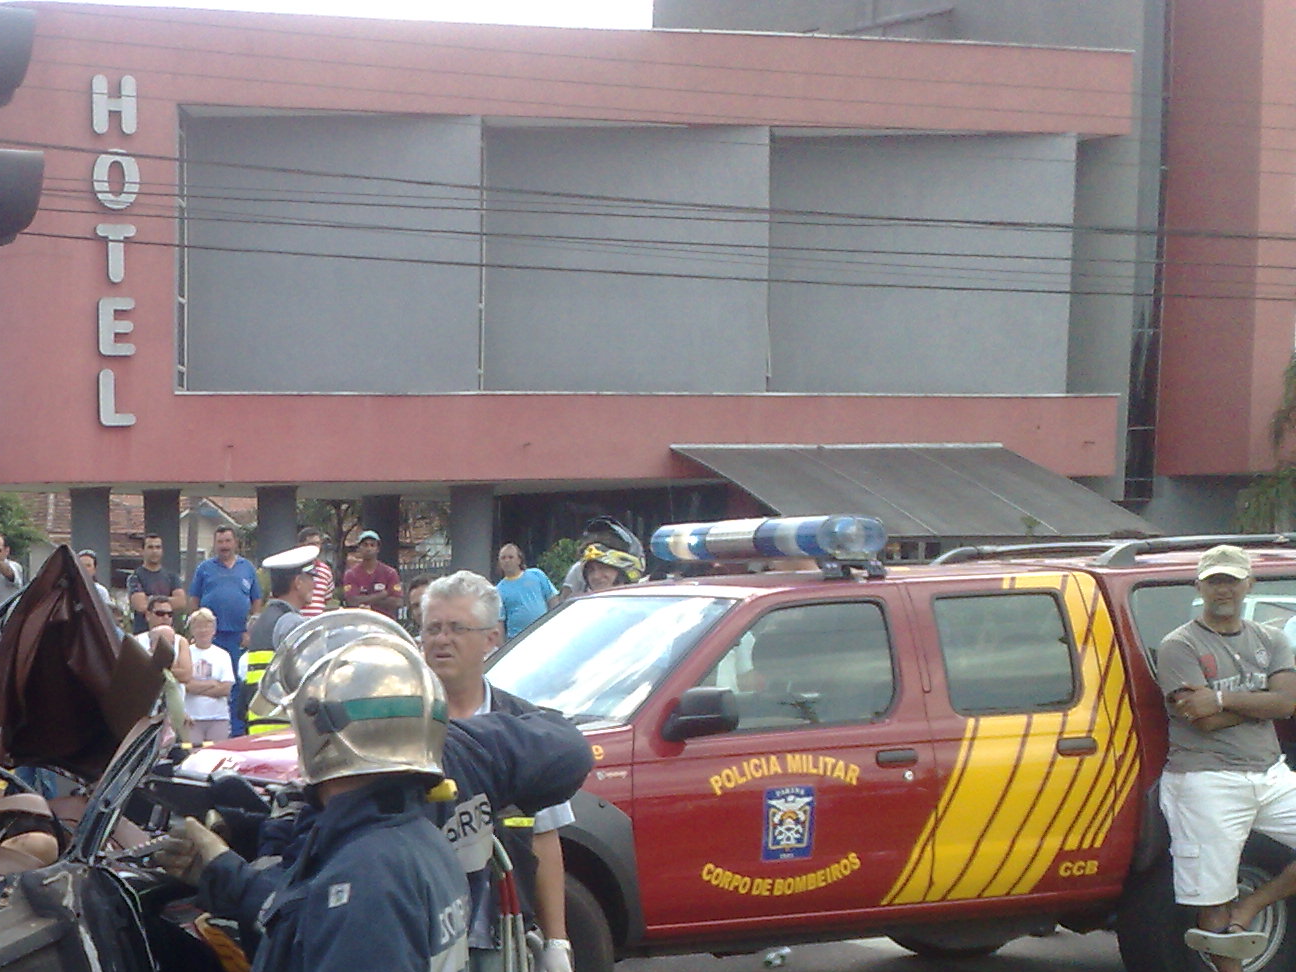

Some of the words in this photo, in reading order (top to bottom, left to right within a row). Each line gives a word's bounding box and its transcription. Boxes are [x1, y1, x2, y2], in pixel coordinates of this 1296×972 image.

[91, 74, 140, 427] HOTEL
[709, 755, 782, 795] POLICIA
[786, 753, 860, 785] MILITAR
[702, 862, 751, 894] CORPO
[752, 878, 773, 896] DE
[773, 852, 861, 896] BOMBEIROS
